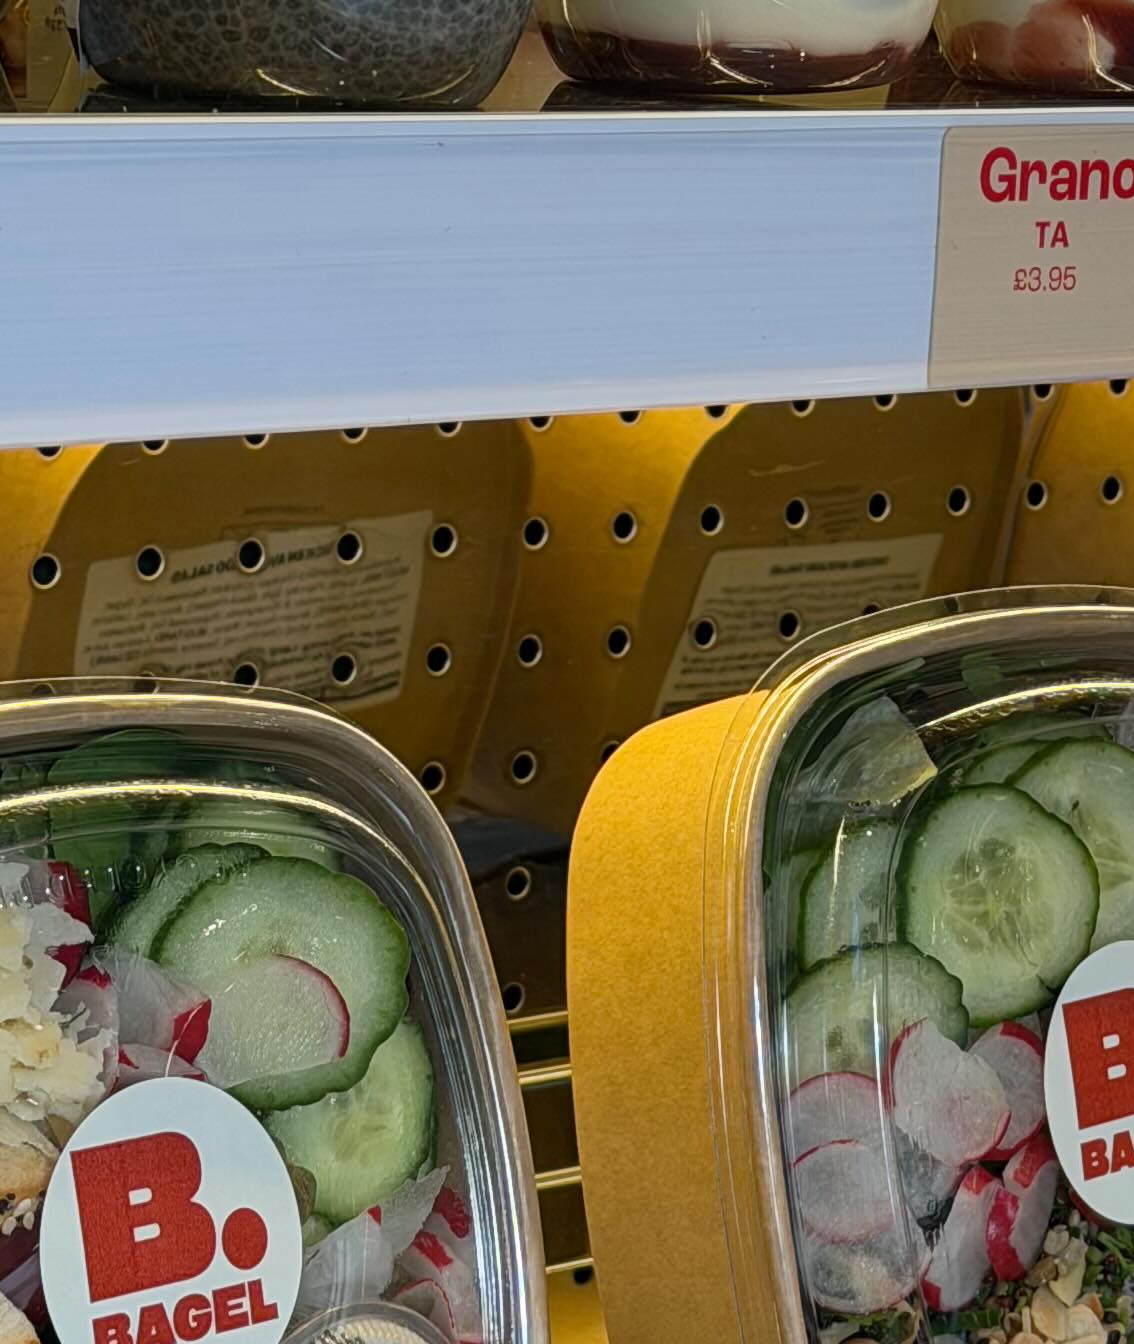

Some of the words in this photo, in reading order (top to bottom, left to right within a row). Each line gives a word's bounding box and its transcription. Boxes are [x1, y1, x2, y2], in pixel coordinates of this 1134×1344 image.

[1035, 221, 1069, 249] TA
[1013, 266, 1077, 292] £3.95
[70, 1131, 268, 1304] B.
